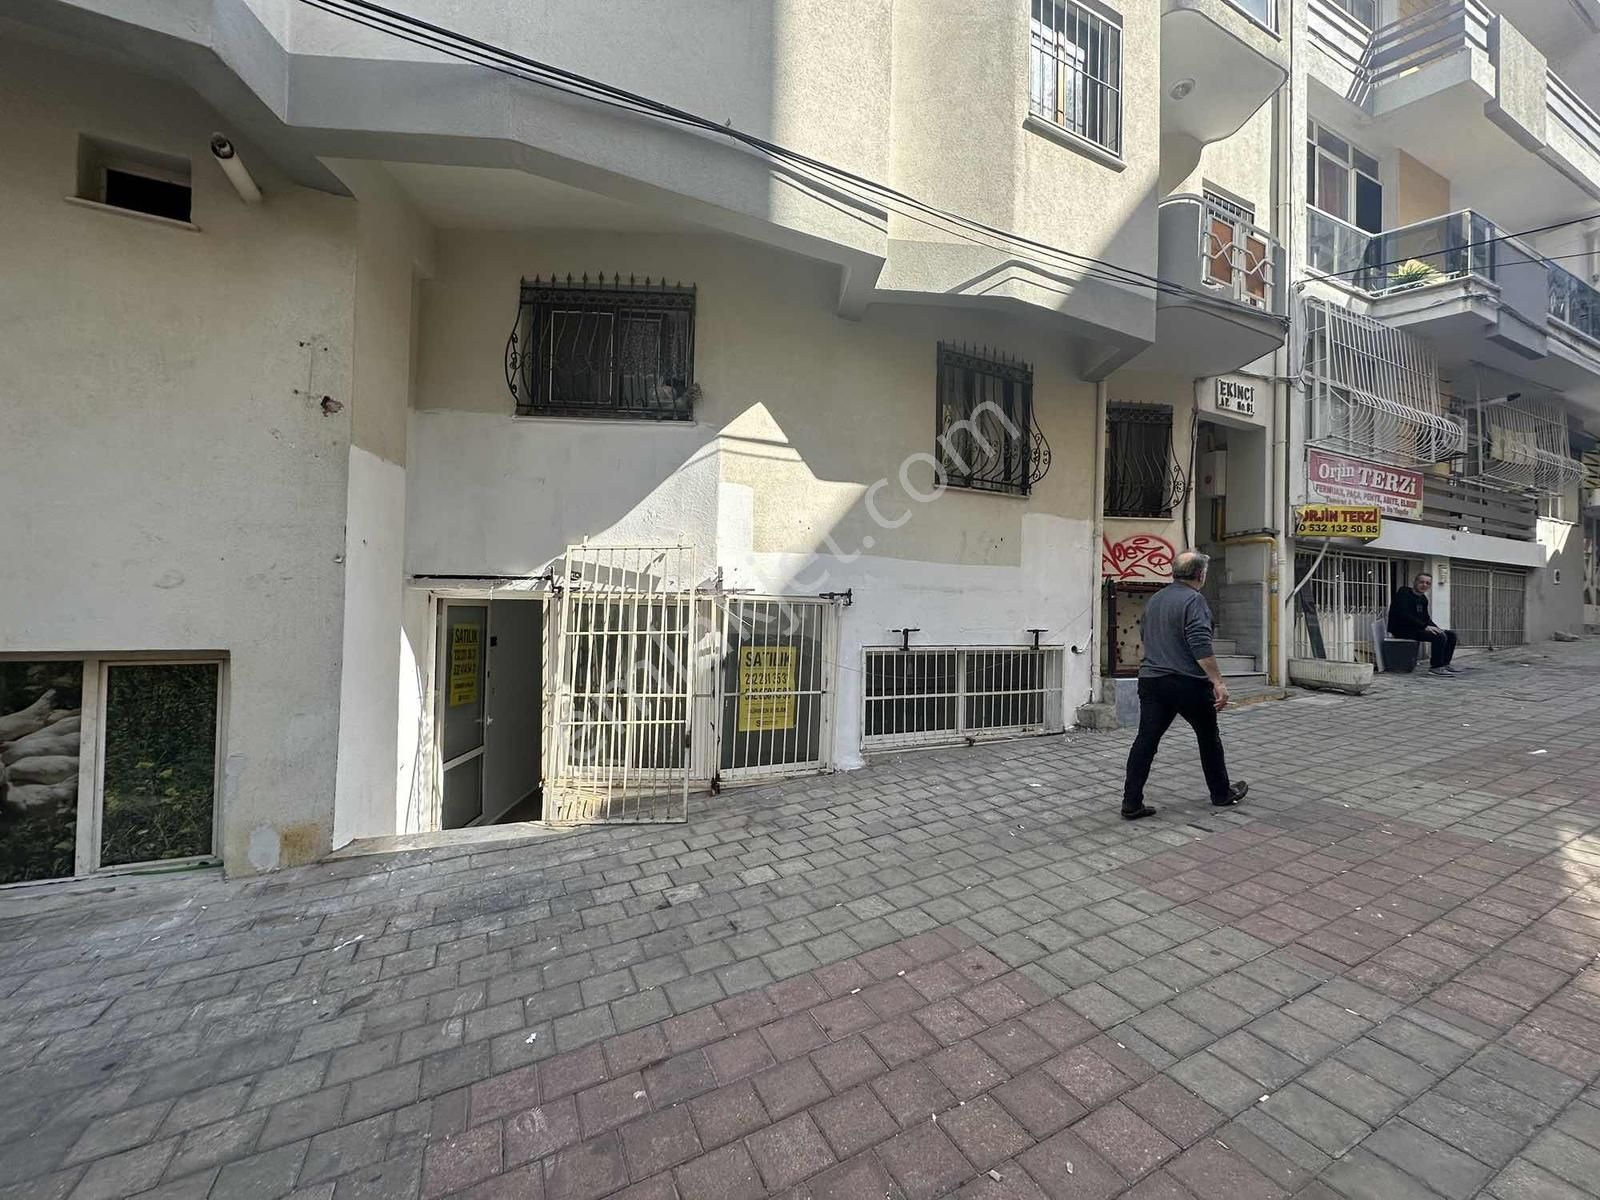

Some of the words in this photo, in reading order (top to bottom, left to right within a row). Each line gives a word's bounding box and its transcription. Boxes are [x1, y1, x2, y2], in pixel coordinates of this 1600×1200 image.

[1318, 463, 1355, 481] Orjin
[1358, 467, 1416, 495] TERZi
[1340, 508, 1378, 523] TERZİ
[1309, 524, 1328, 532] 532
[1331, 524, 1348, 532] 132
[1366, 525, 1378, 533] 85
[745, 672, 758, 685] 22
